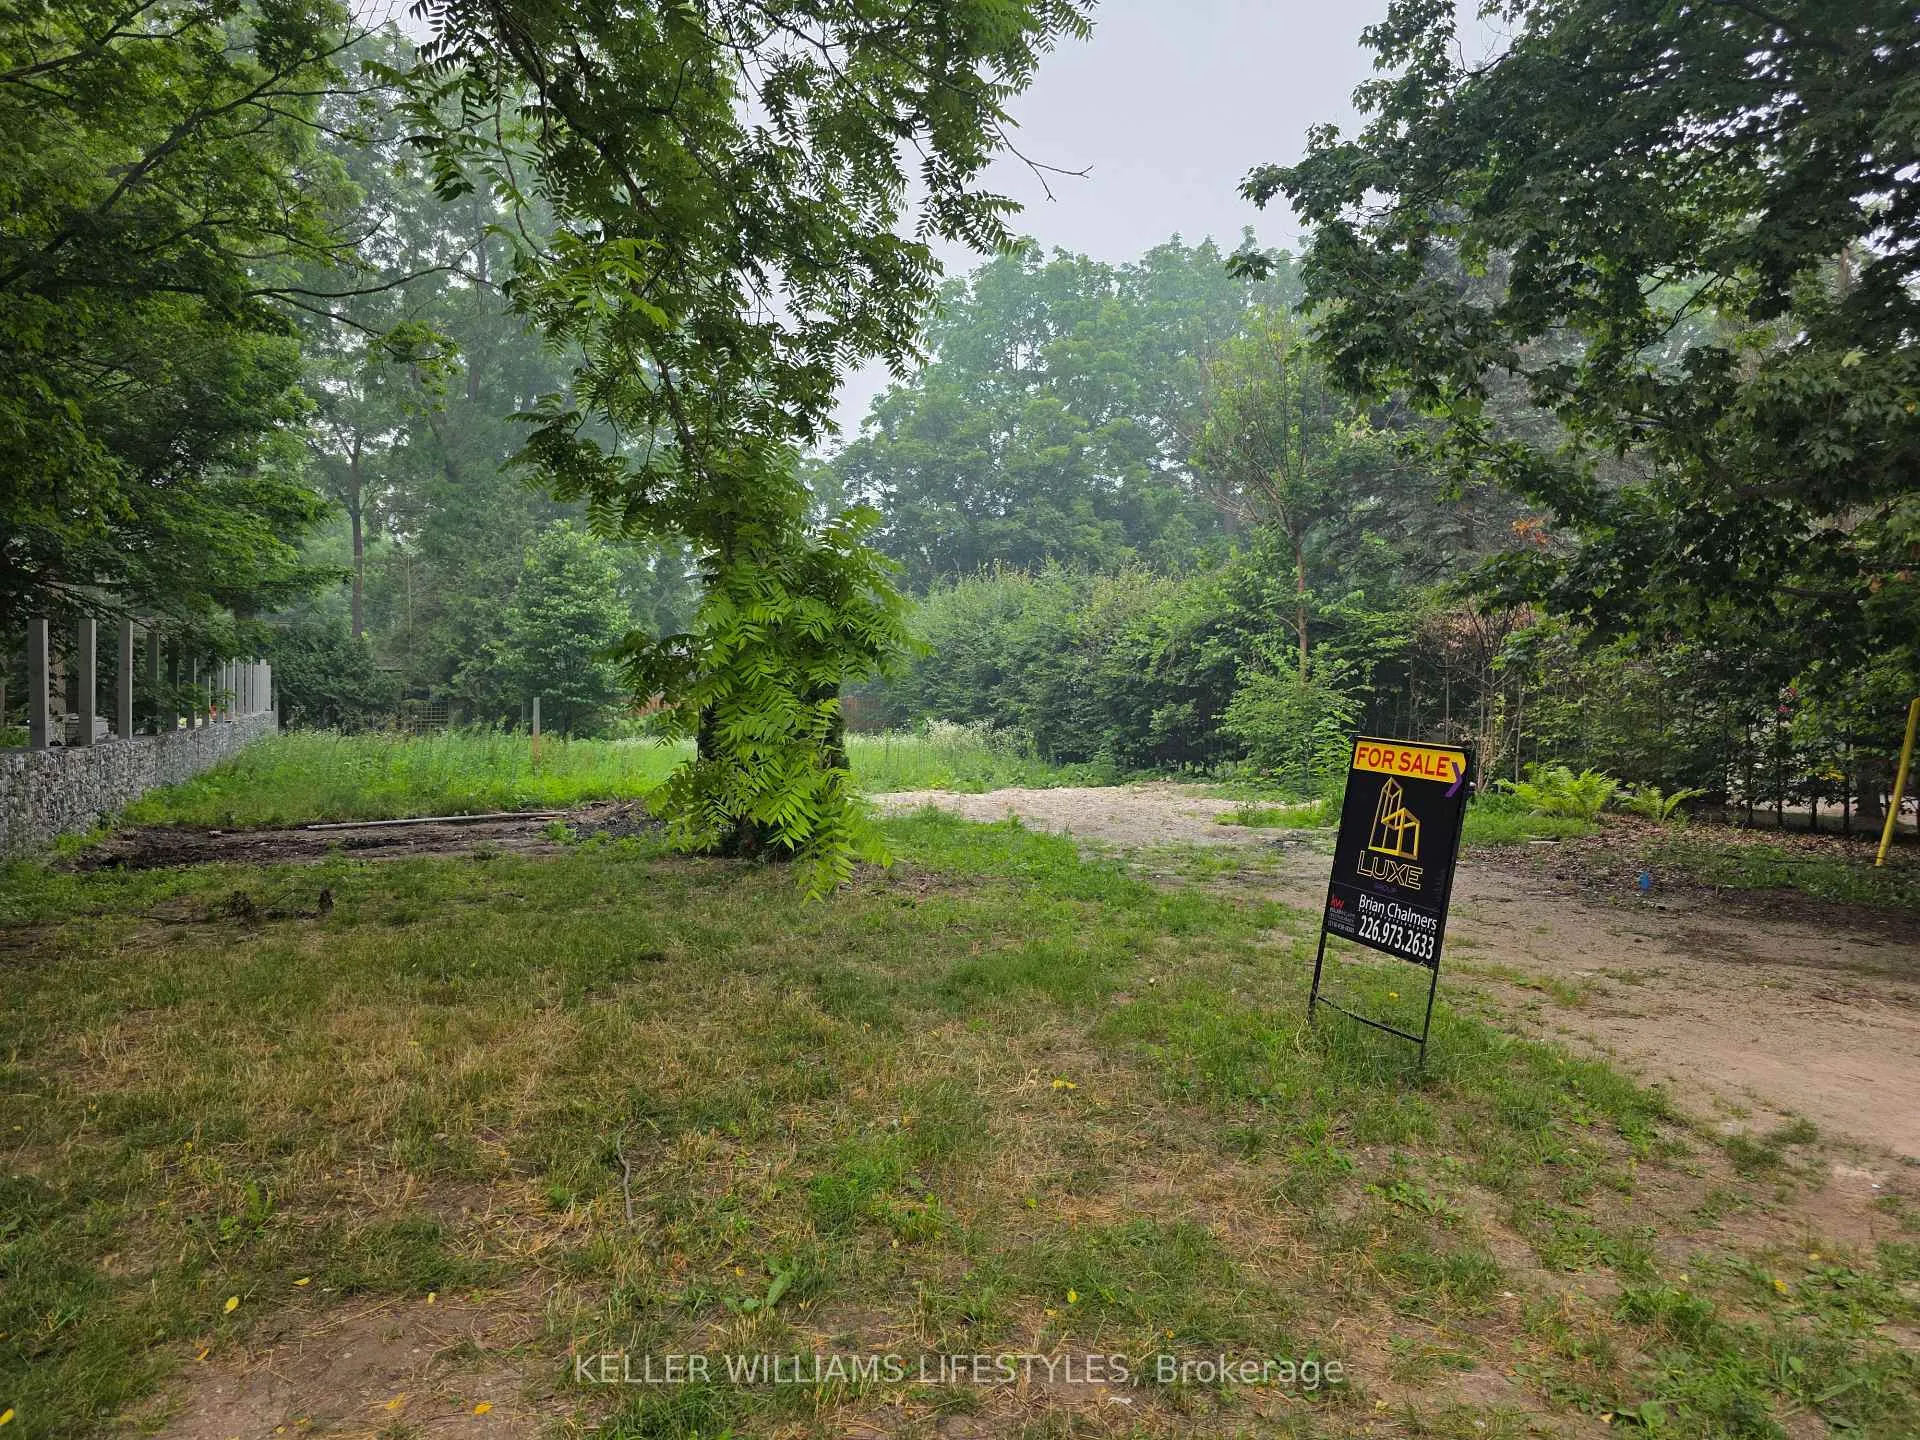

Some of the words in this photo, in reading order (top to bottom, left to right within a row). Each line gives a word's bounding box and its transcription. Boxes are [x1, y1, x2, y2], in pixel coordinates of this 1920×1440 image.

[1357, 747, 1395, 769] FOR
[1398, 752, 1450, 777] SALE
[1356, 850, 1424, 890] LUXE
[1359, 894, 1385, 915] Brian
[1387, 903, 1438, 930] Chalmers
[1358, 915, 1435, 960] 226.973.2633
